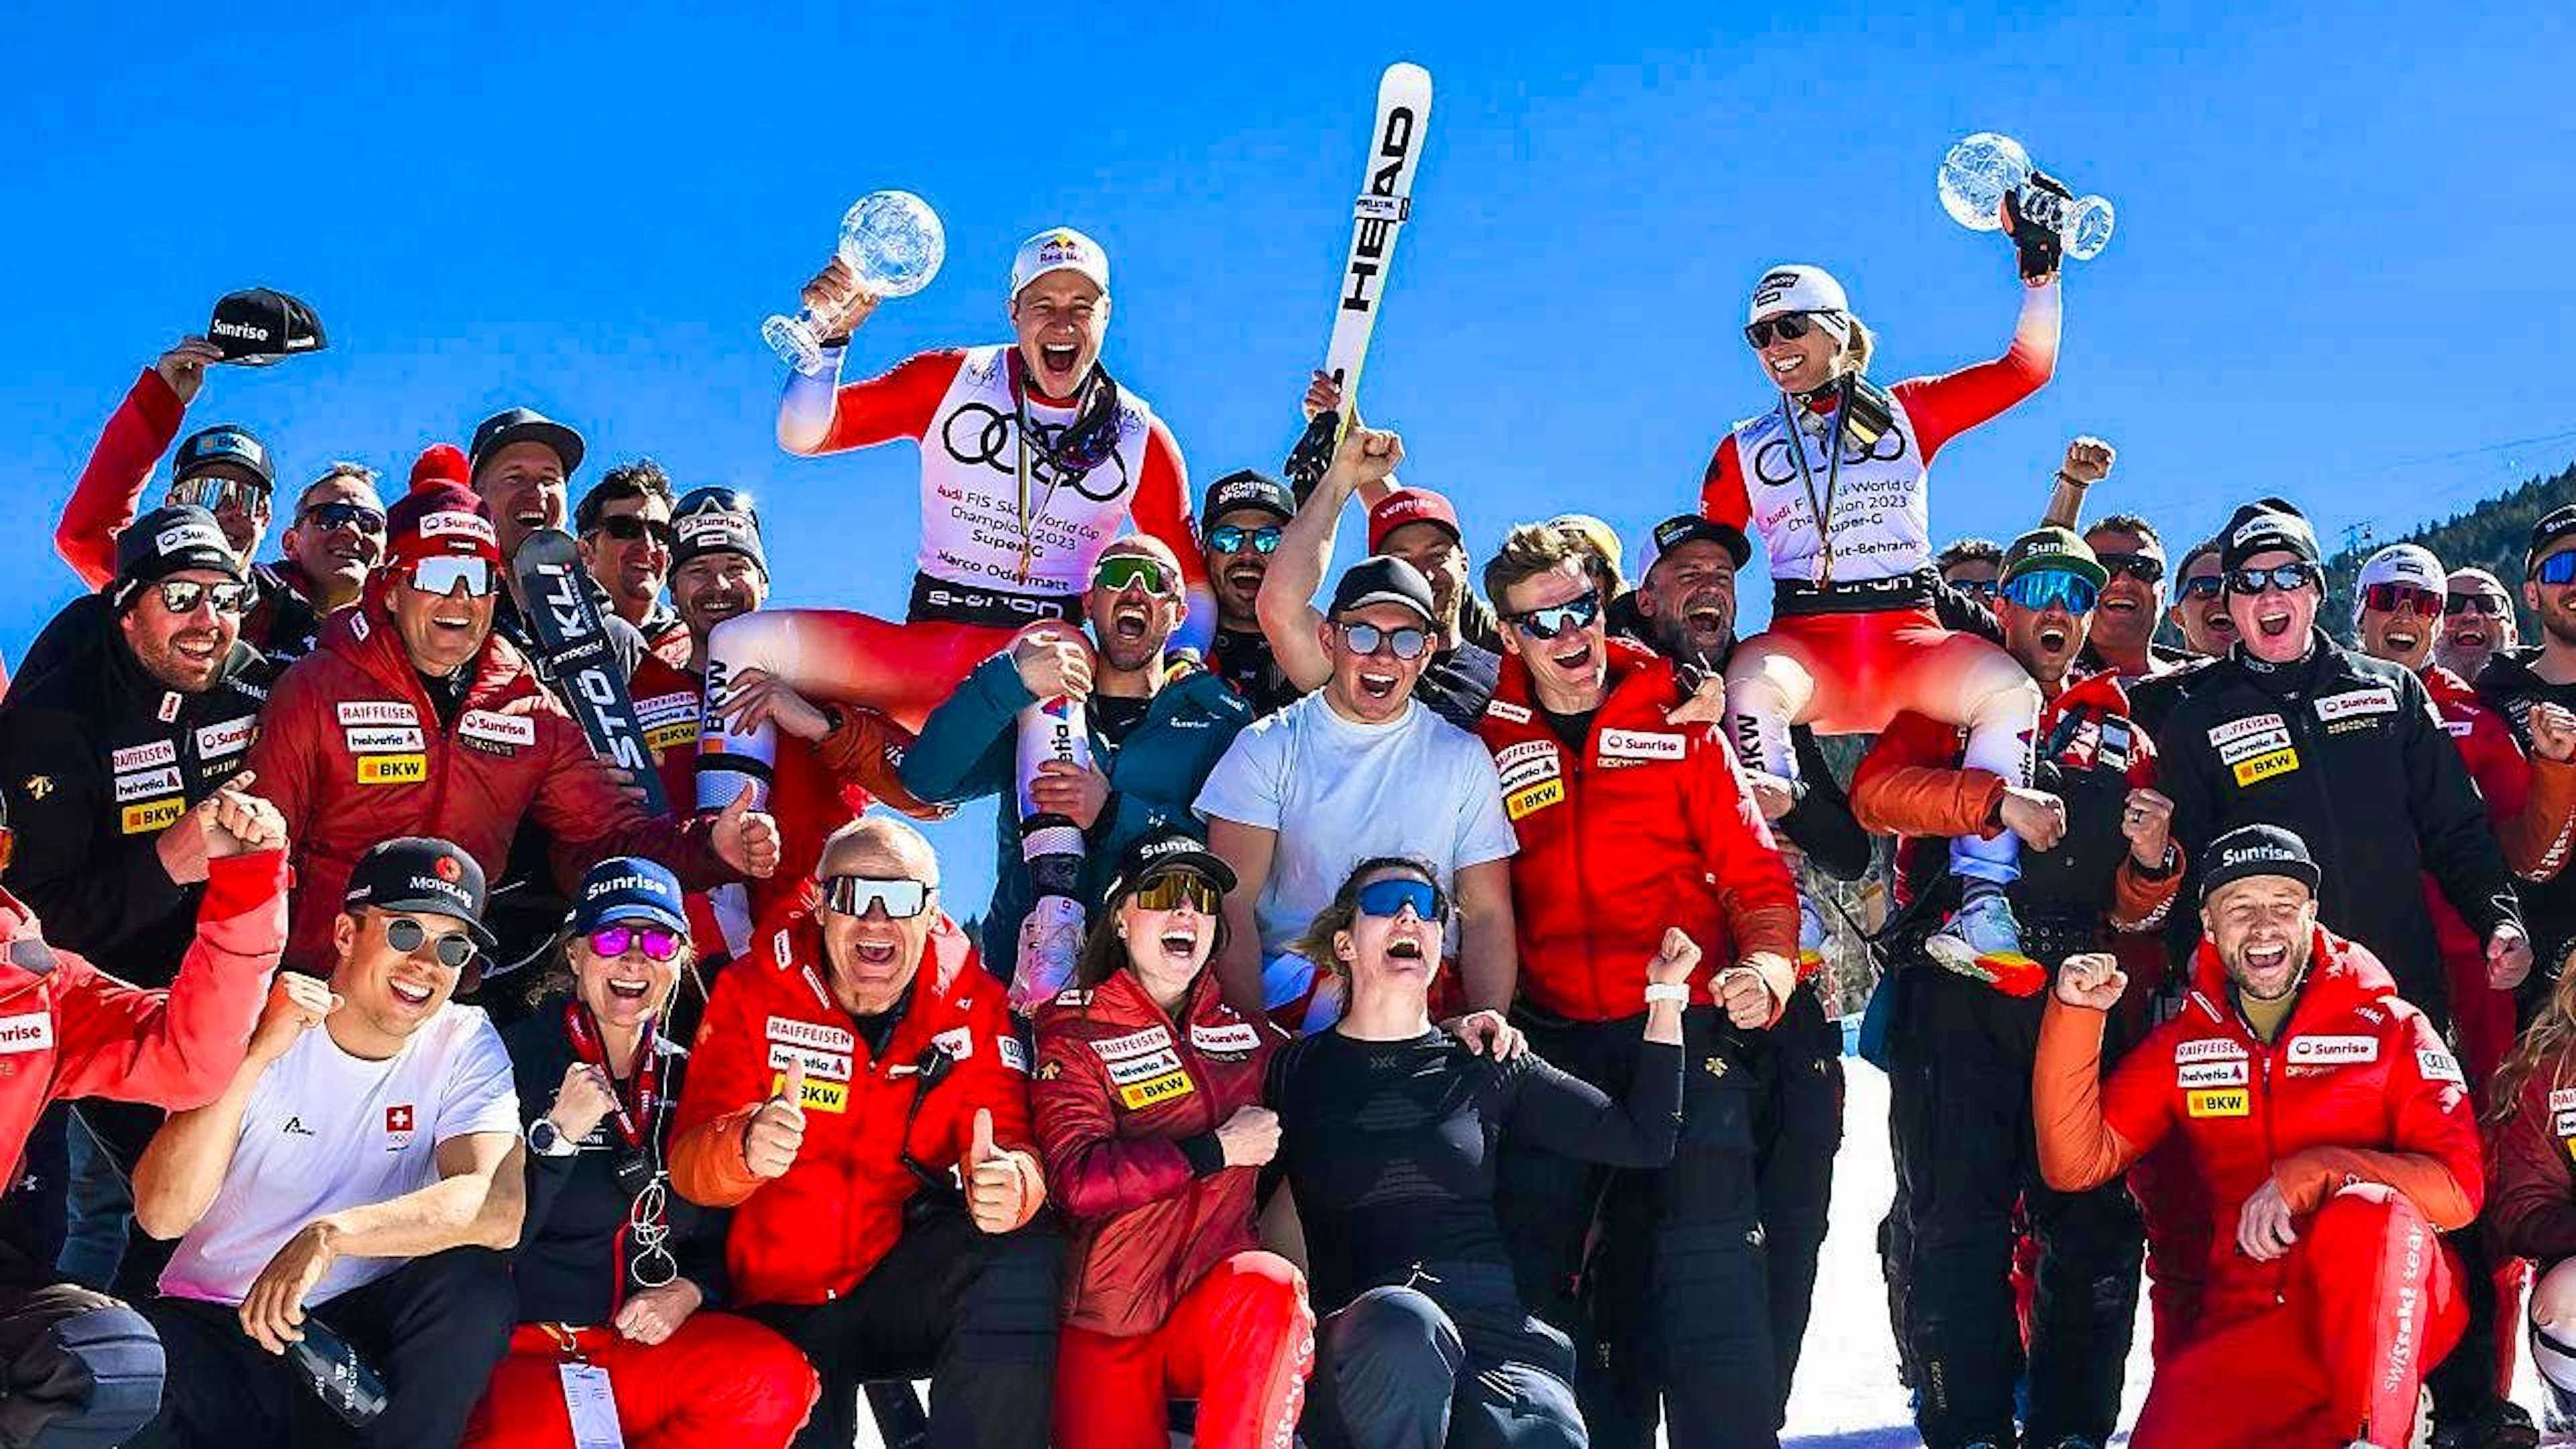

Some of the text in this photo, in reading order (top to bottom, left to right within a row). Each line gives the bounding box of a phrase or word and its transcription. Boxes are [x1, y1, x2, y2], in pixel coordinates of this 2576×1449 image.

[1343, 107, 1413, 311] HEAD
[213, 318, 269, 341] Sunrise
[938, 484, 962, 500] Audi
[967, 492, 991, 508] FIS
[1868, 495, 1907, 509] 2023
[951, 506, 1075, 550] Champio 2023
[1829, 513, 1884, 533] uper-G
[972, 529, 1044, 557] SuperG
[938, 549, 1069, 591] Marco Odematt
[704, 660, 728, 733] BKW
[342, 706, 415, 720] RAIFFEISEN
[478, 716, 526, 736] Sunrise
[1625, 737, 1677, 752] Sunrise
[380, 762, 419, 776] BKW
[2254, 755, 2290, 773] BKW
[1524, 786, 1557, 808] BKW
[144, 805, 180, 824] BKW
[2221, 843, 2296, 867] Sunrise
[586, 872, 668, 901] Sunrise
[0, 1025, 41, 1041] nrise
[770, 1019, 851, 1046] RAIFFEISEN
[2314, 1041, 2369, 1055] Sunrise
[773, 1049, 828, 1072] heetia
[1144, 1076, 1184, 1097] BKW
[2206, 1095, 2242, 1110] BKW
